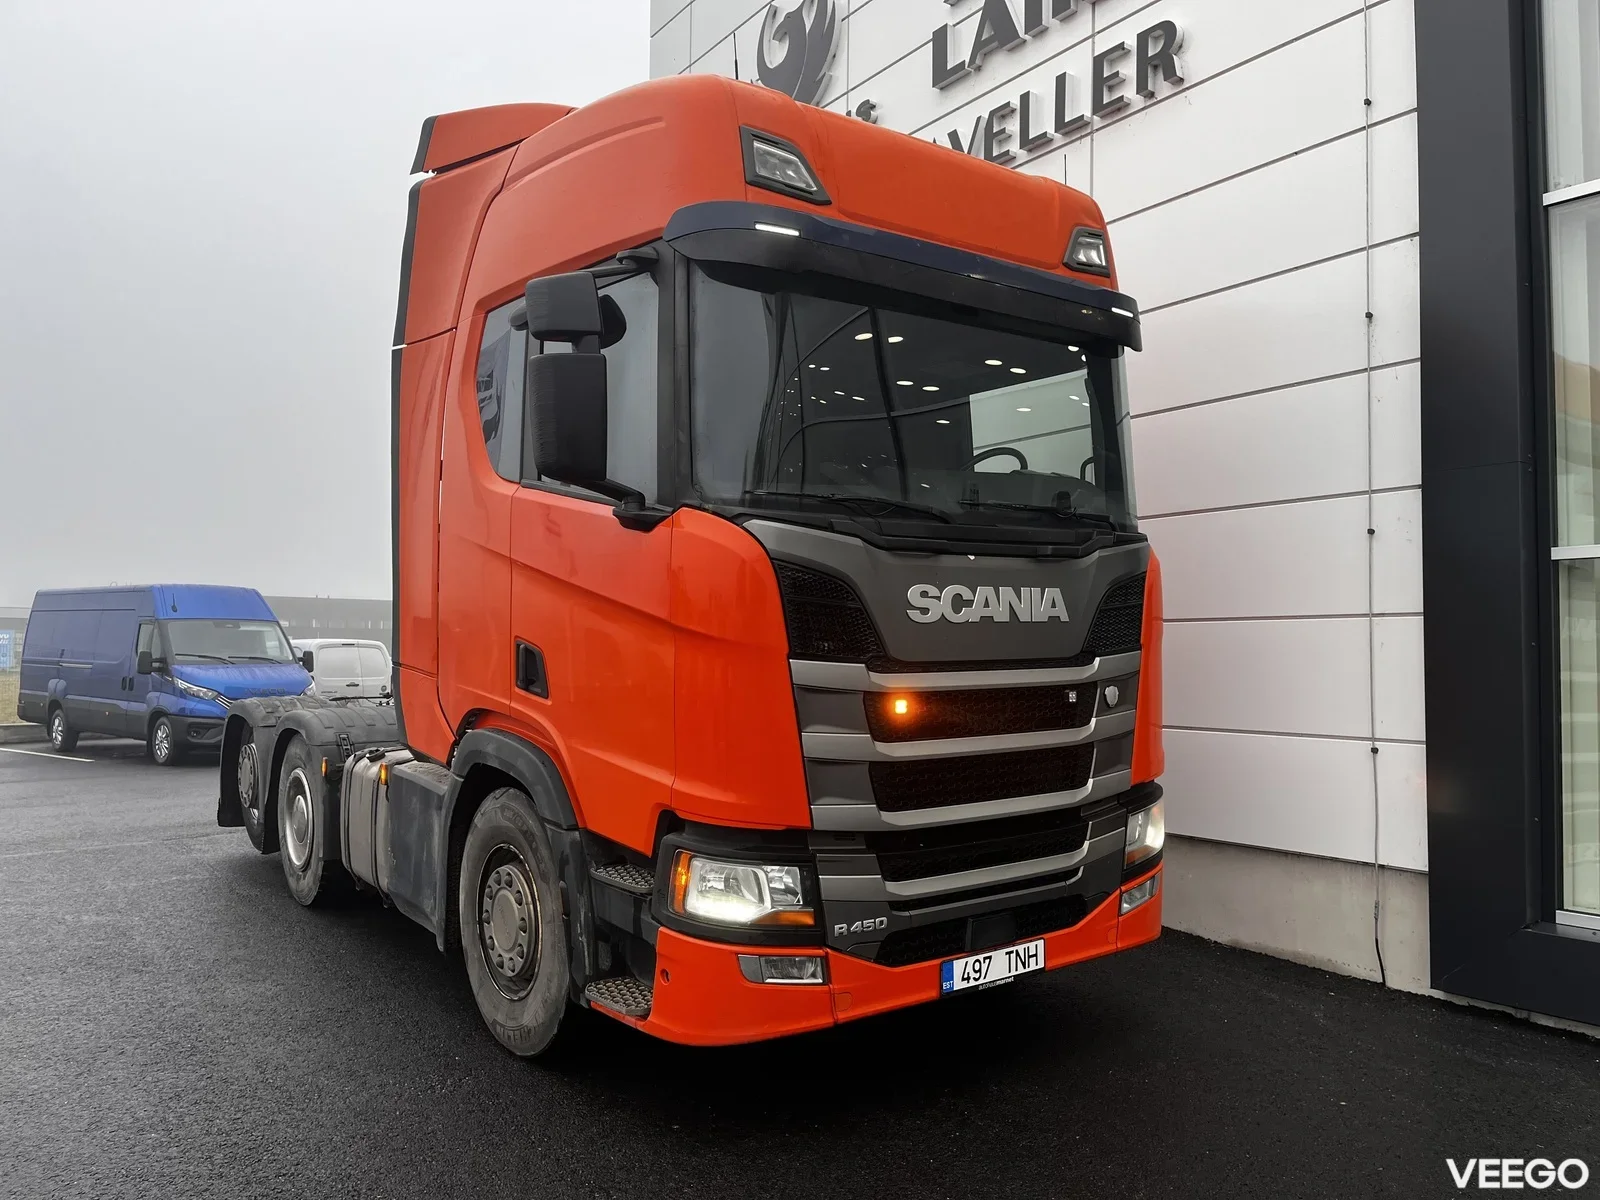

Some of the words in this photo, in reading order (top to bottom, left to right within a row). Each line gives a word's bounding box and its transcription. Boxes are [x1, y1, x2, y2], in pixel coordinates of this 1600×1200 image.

[907, 584, 1069, 623] SCANIA
[834, 923, 848, 938] R
[850, 916, 888, 934] 450
[960, 954, 993, 985] 497
[1004, 943, 1039, 974] TNH
[942, 980, 954, 990] EST
